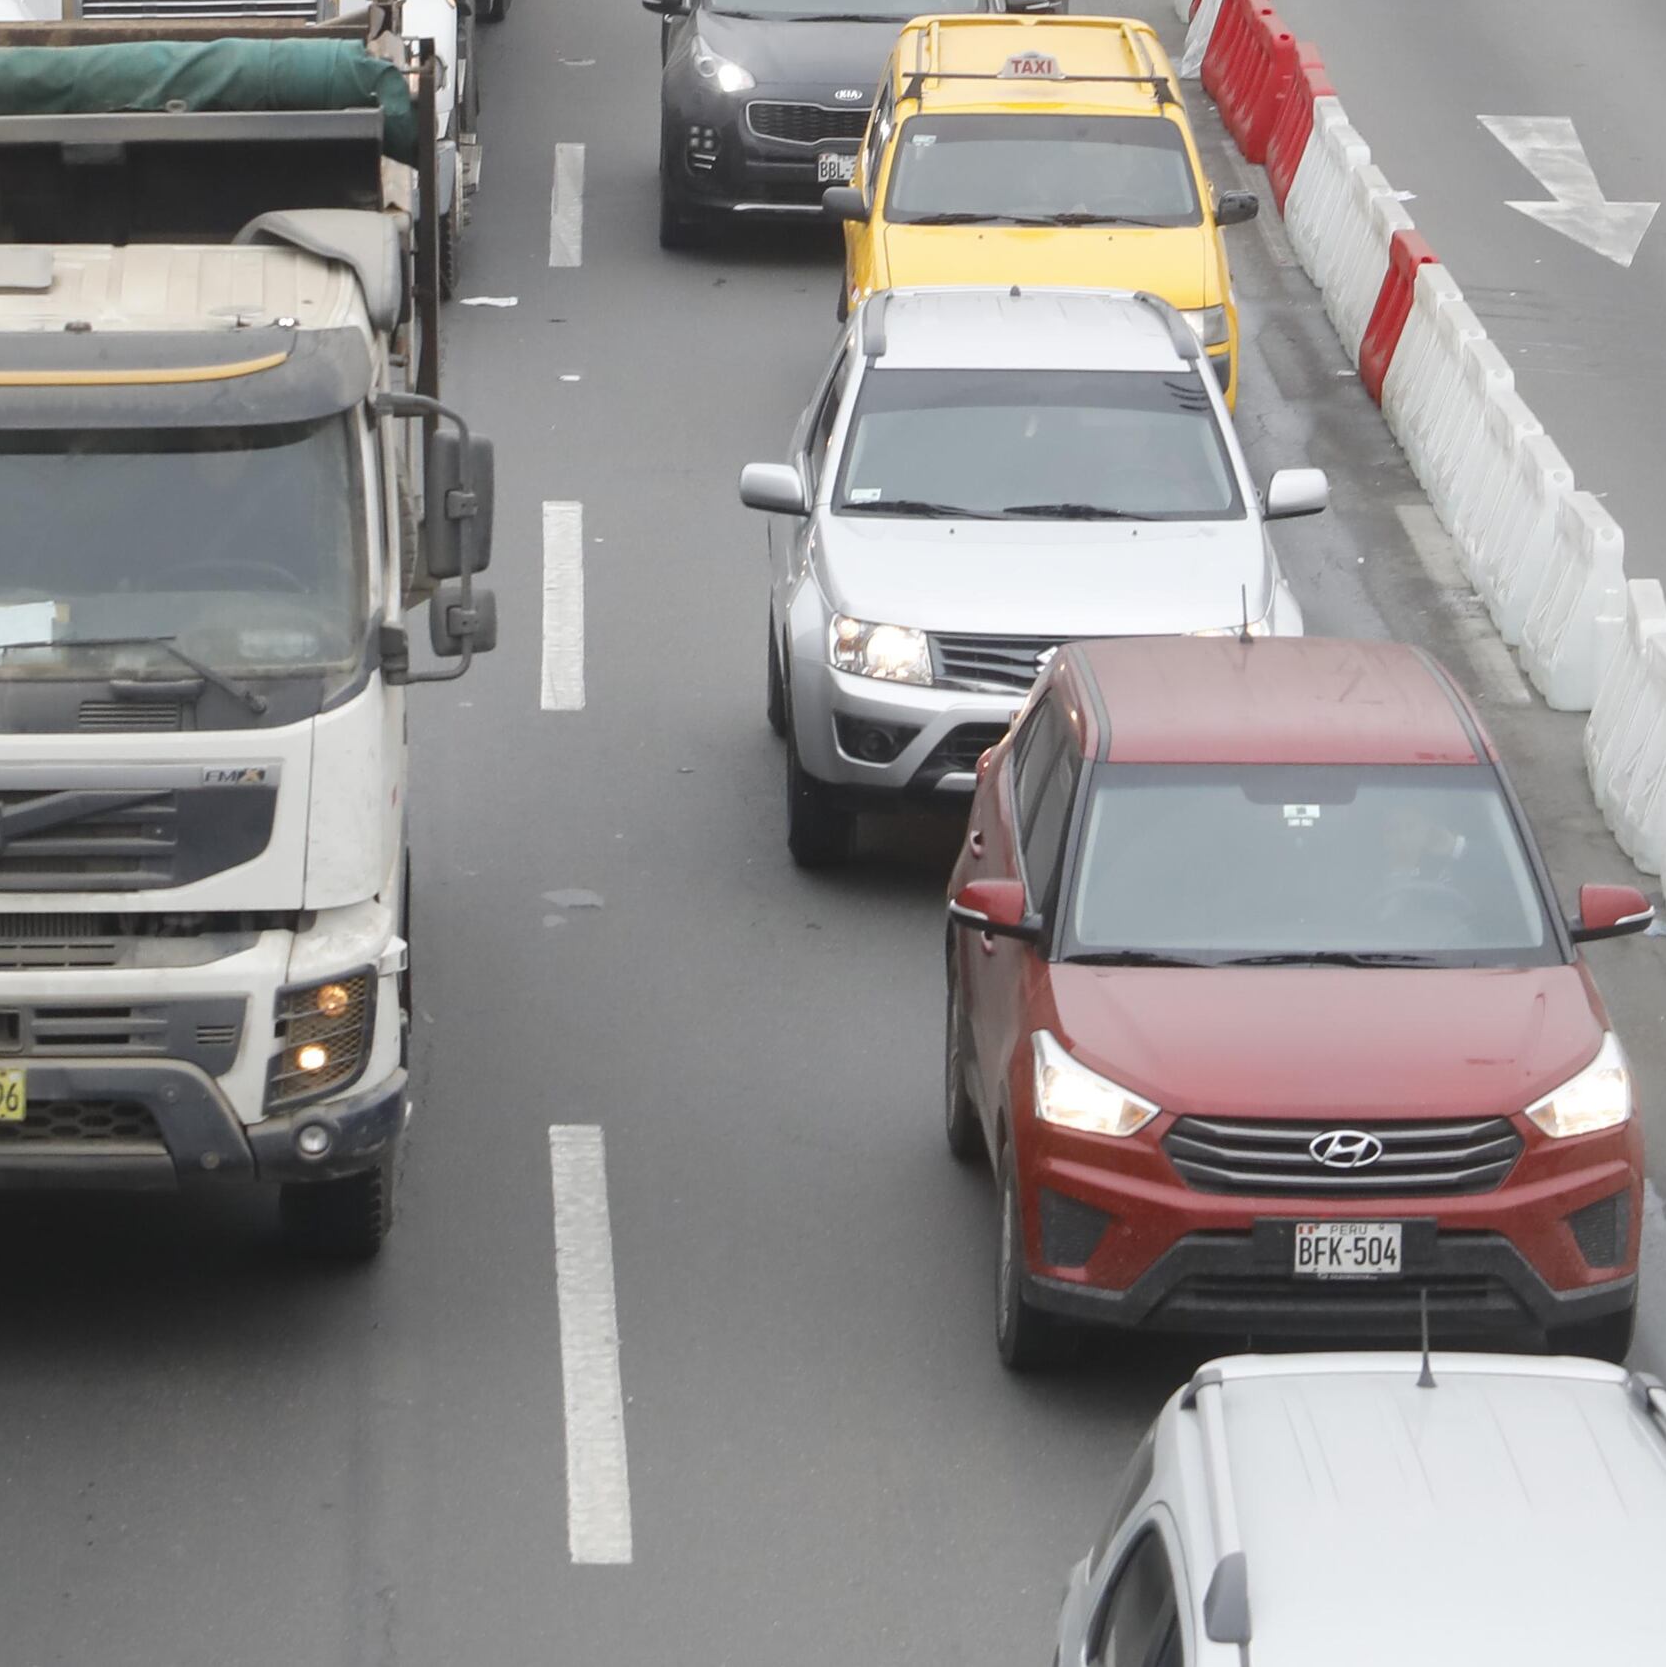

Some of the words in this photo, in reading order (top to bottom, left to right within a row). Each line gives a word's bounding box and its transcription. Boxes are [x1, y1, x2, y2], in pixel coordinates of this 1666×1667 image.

[1011, 60, 1053, 74] TAXI
[836, 89, 862, 99] KIA
[1330, 1224, 1367, 1236] PERU
[1299, 1237, 1397, 1266] BFK-504
